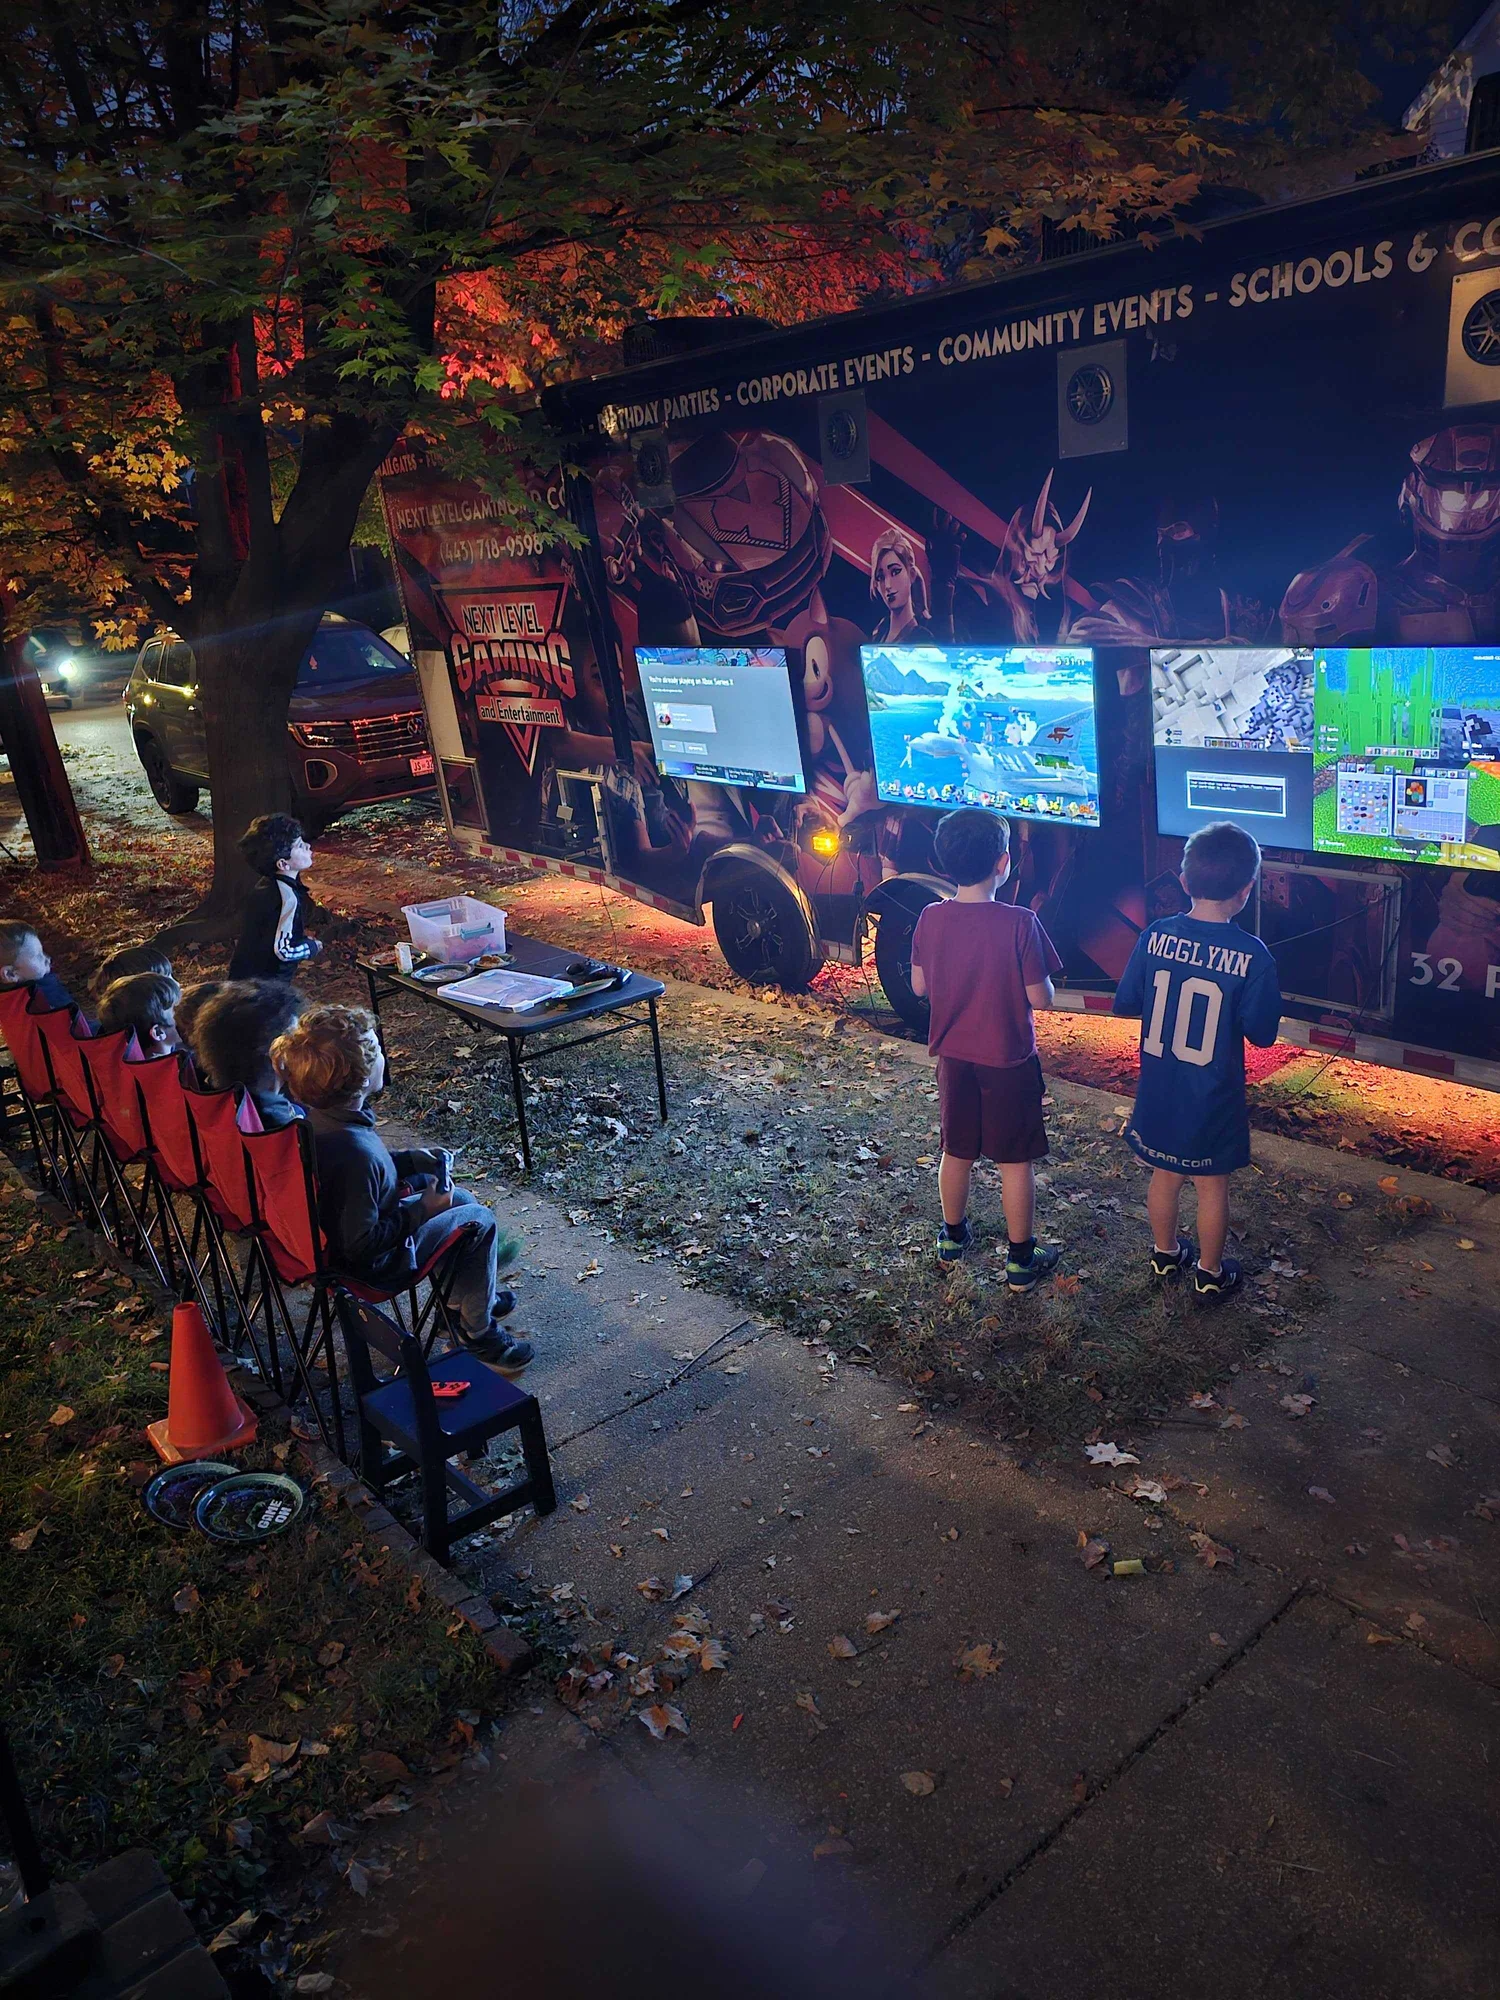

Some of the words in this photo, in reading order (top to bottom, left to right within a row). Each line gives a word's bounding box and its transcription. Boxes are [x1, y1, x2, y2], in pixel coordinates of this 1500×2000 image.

[663, 387, 720, 421] PARTIES
[736, 362, 839, 406] CORPORATE
[844, 345, 915, 386] EVENTS
[938, 306, 1083, 366] COMMUNITY
[1093, 284, 1193, 336] EVENTS
[1228, 240, 1394, 308] SCHOOLS
[1407, 231, 1438, 273] &
[439, 540, 475, 566] (443)
[462, 604, 498, 634] NEXT
[500, 603, 544, 633] LEVEL
[450, 633, 577, 699] GAMING
[481, 699, 497, 720] and
[499, 700, 561, 725] Entertainment
[1147, 930, 1253, 978] MCGLYNN
[1409, 951, 1463, 992] 32
[1143, 969, 1224, 1067] 10
